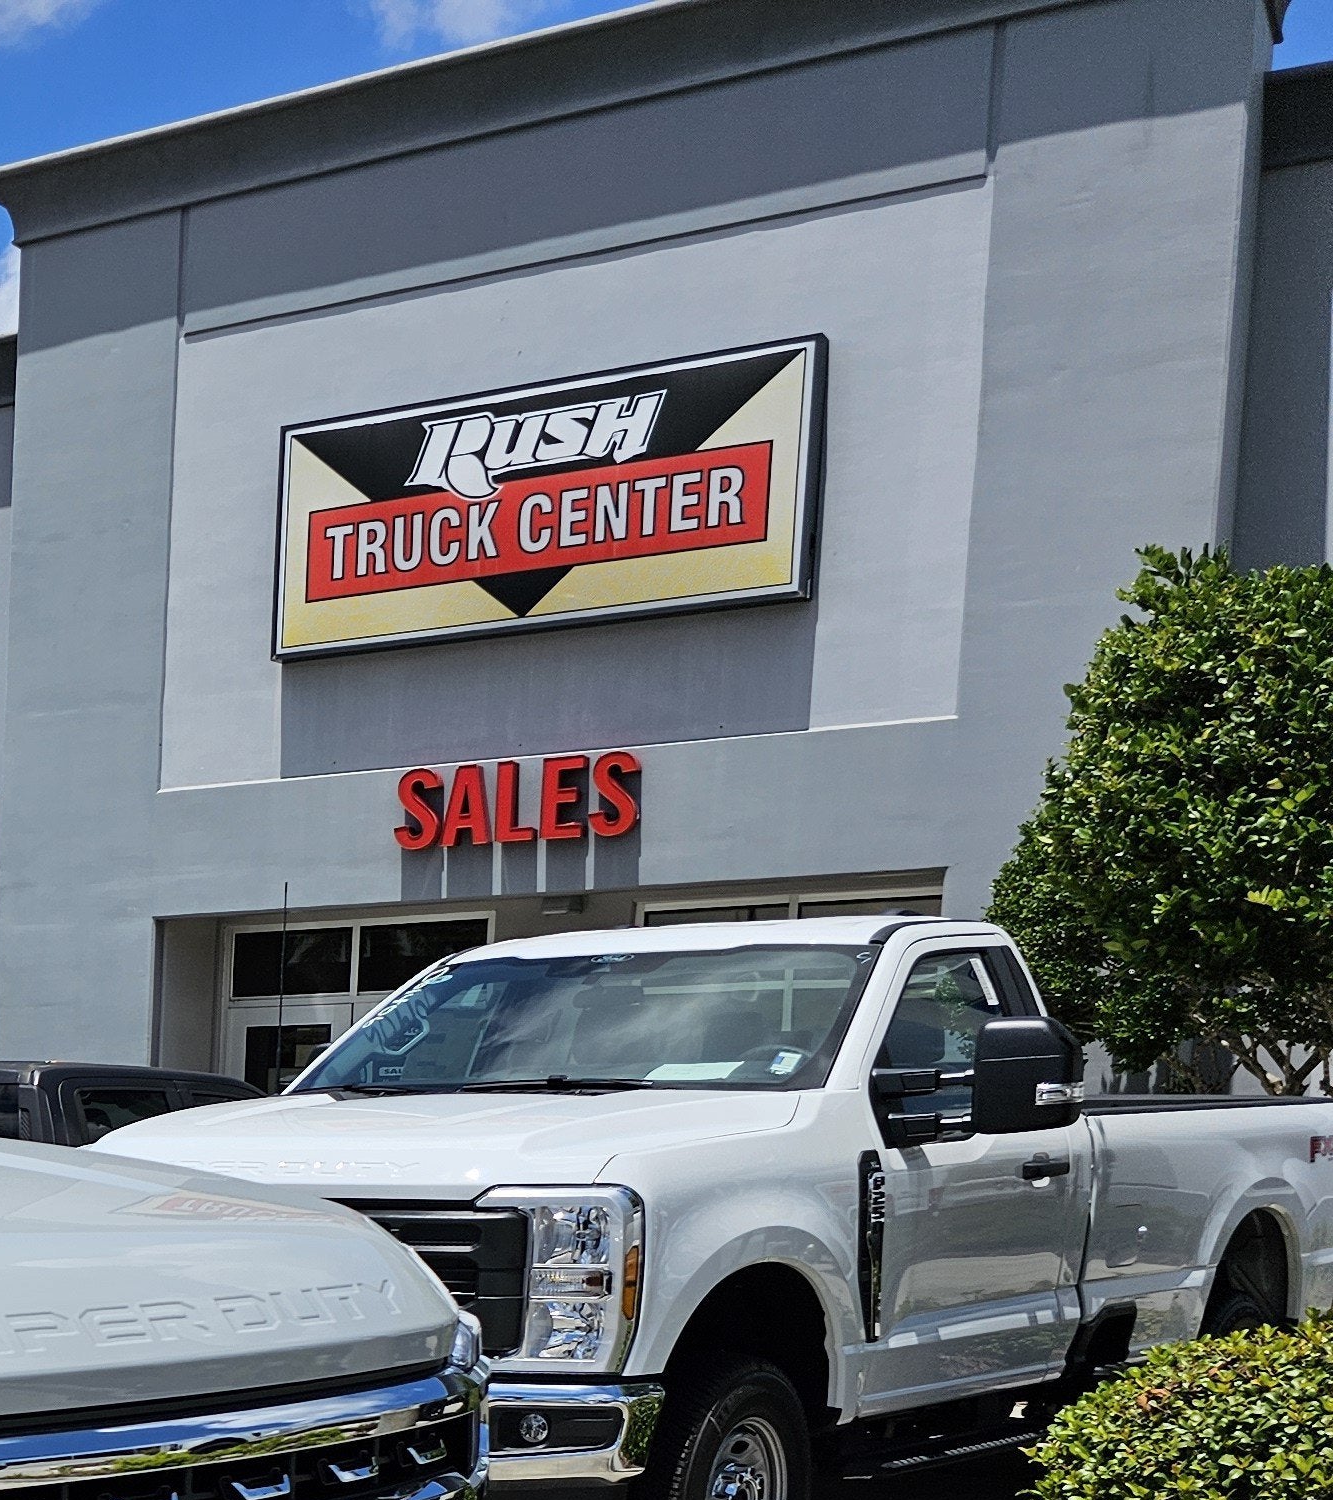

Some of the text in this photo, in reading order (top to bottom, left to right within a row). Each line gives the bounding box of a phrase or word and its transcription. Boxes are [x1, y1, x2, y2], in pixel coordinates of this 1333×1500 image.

[405, 390, 667, 500] RUSH
[325, 467, 745, 582] TRUCK CENTER
[394, 751, 640, 850] SALES
[214, 1279, 403, 1334] DUTY
